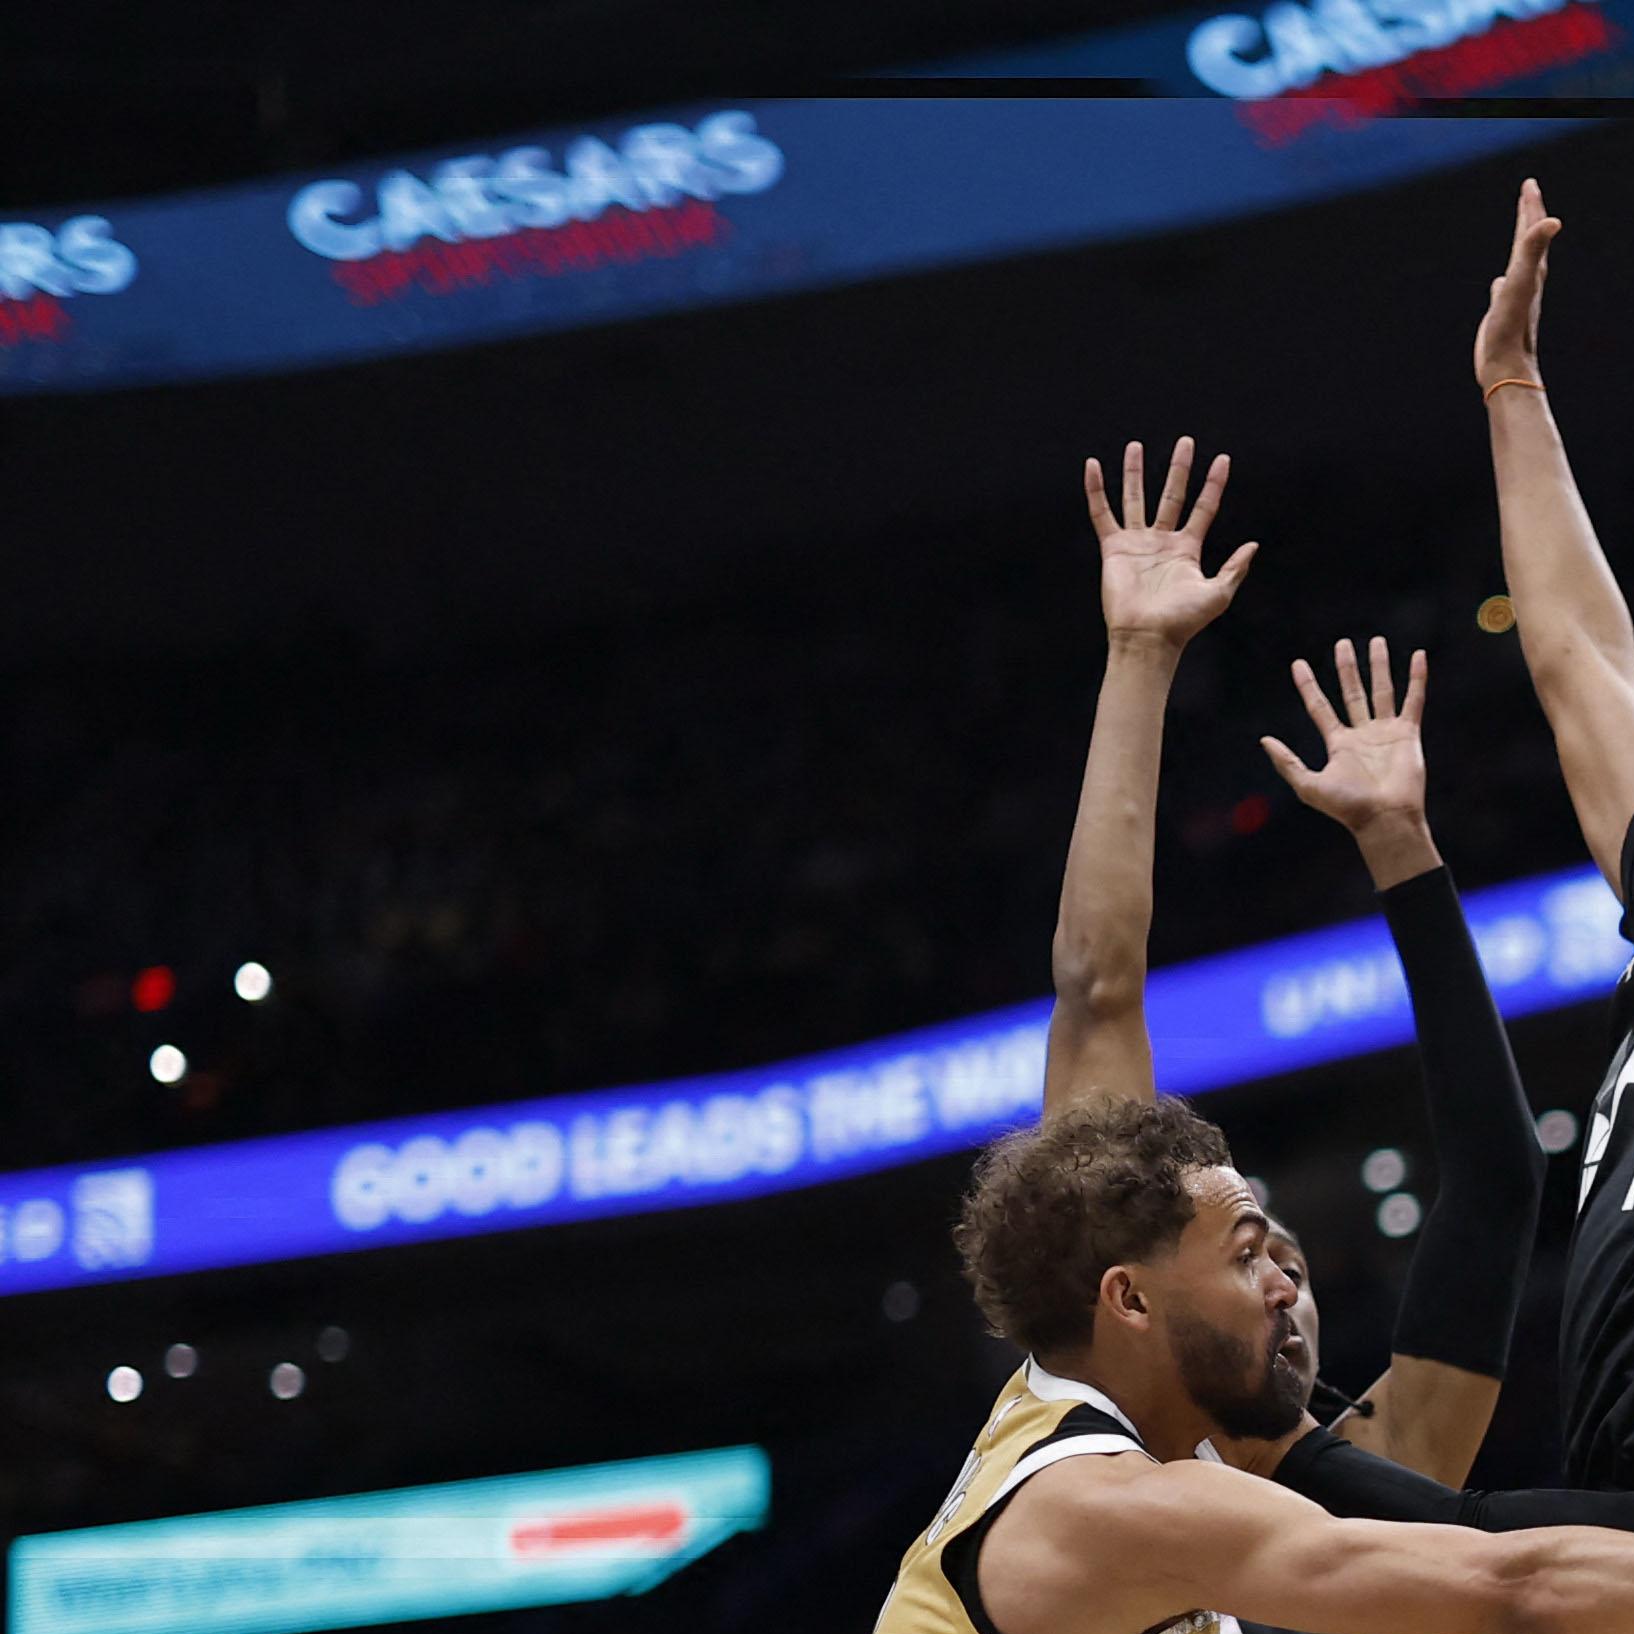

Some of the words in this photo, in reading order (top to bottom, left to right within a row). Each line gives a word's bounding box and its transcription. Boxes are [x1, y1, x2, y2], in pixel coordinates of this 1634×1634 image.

[286, 109, 784, 261] CAESARS
[331, 1120, 564, 1231] GOOD
[568, 1083, 803, 1201] LEADS
[804, 1053, 932, 1164] THE
